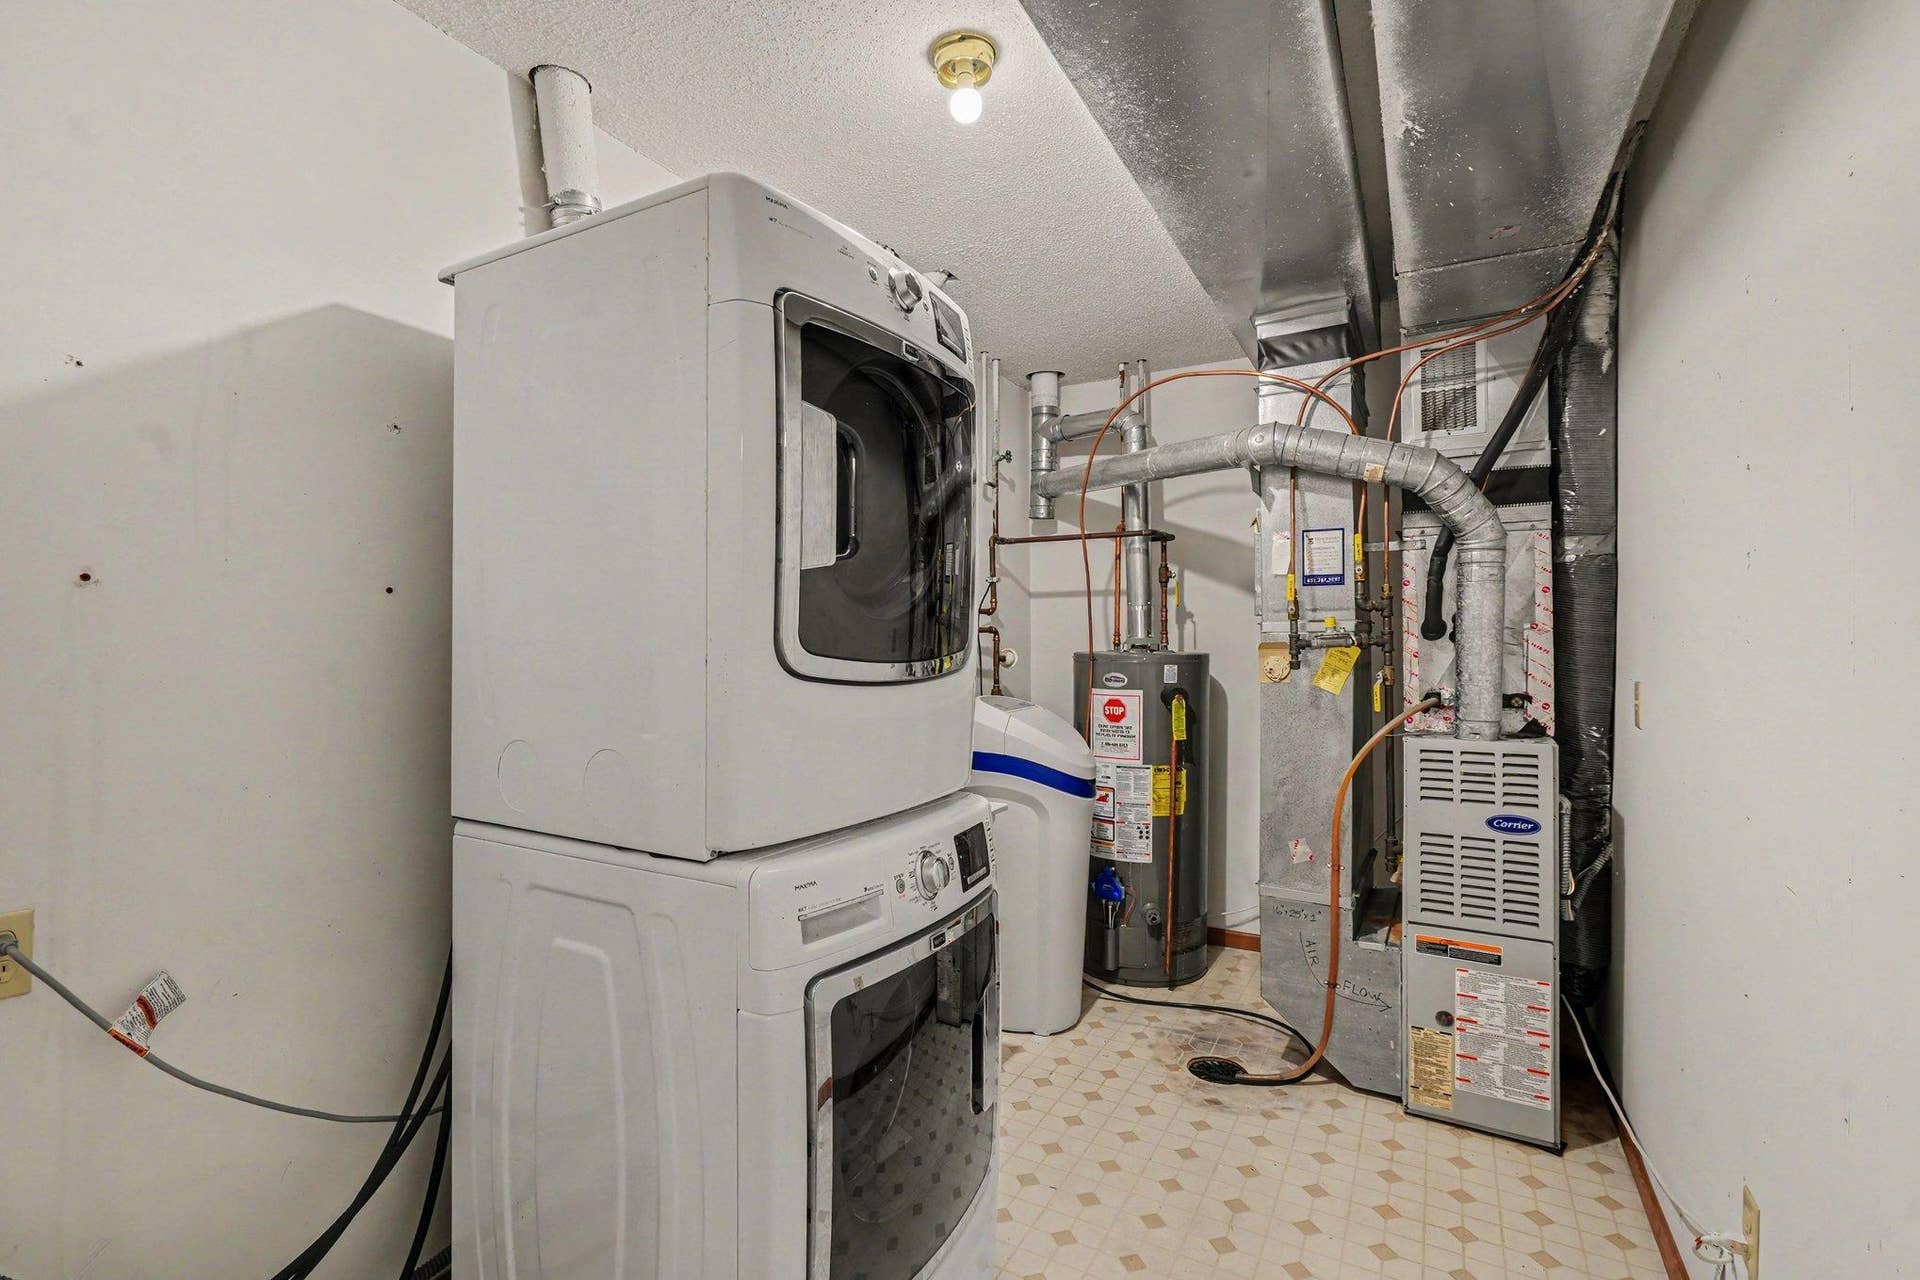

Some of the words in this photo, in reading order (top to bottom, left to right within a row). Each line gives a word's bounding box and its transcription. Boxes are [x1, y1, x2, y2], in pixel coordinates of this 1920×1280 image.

[1104, 705, 1125, 716] STOP
[1493, 819, 1534, 830] Carrier
[1305, 940, 1320, 967] AIR
[1342, 979, 1383, 1002] FLOW
